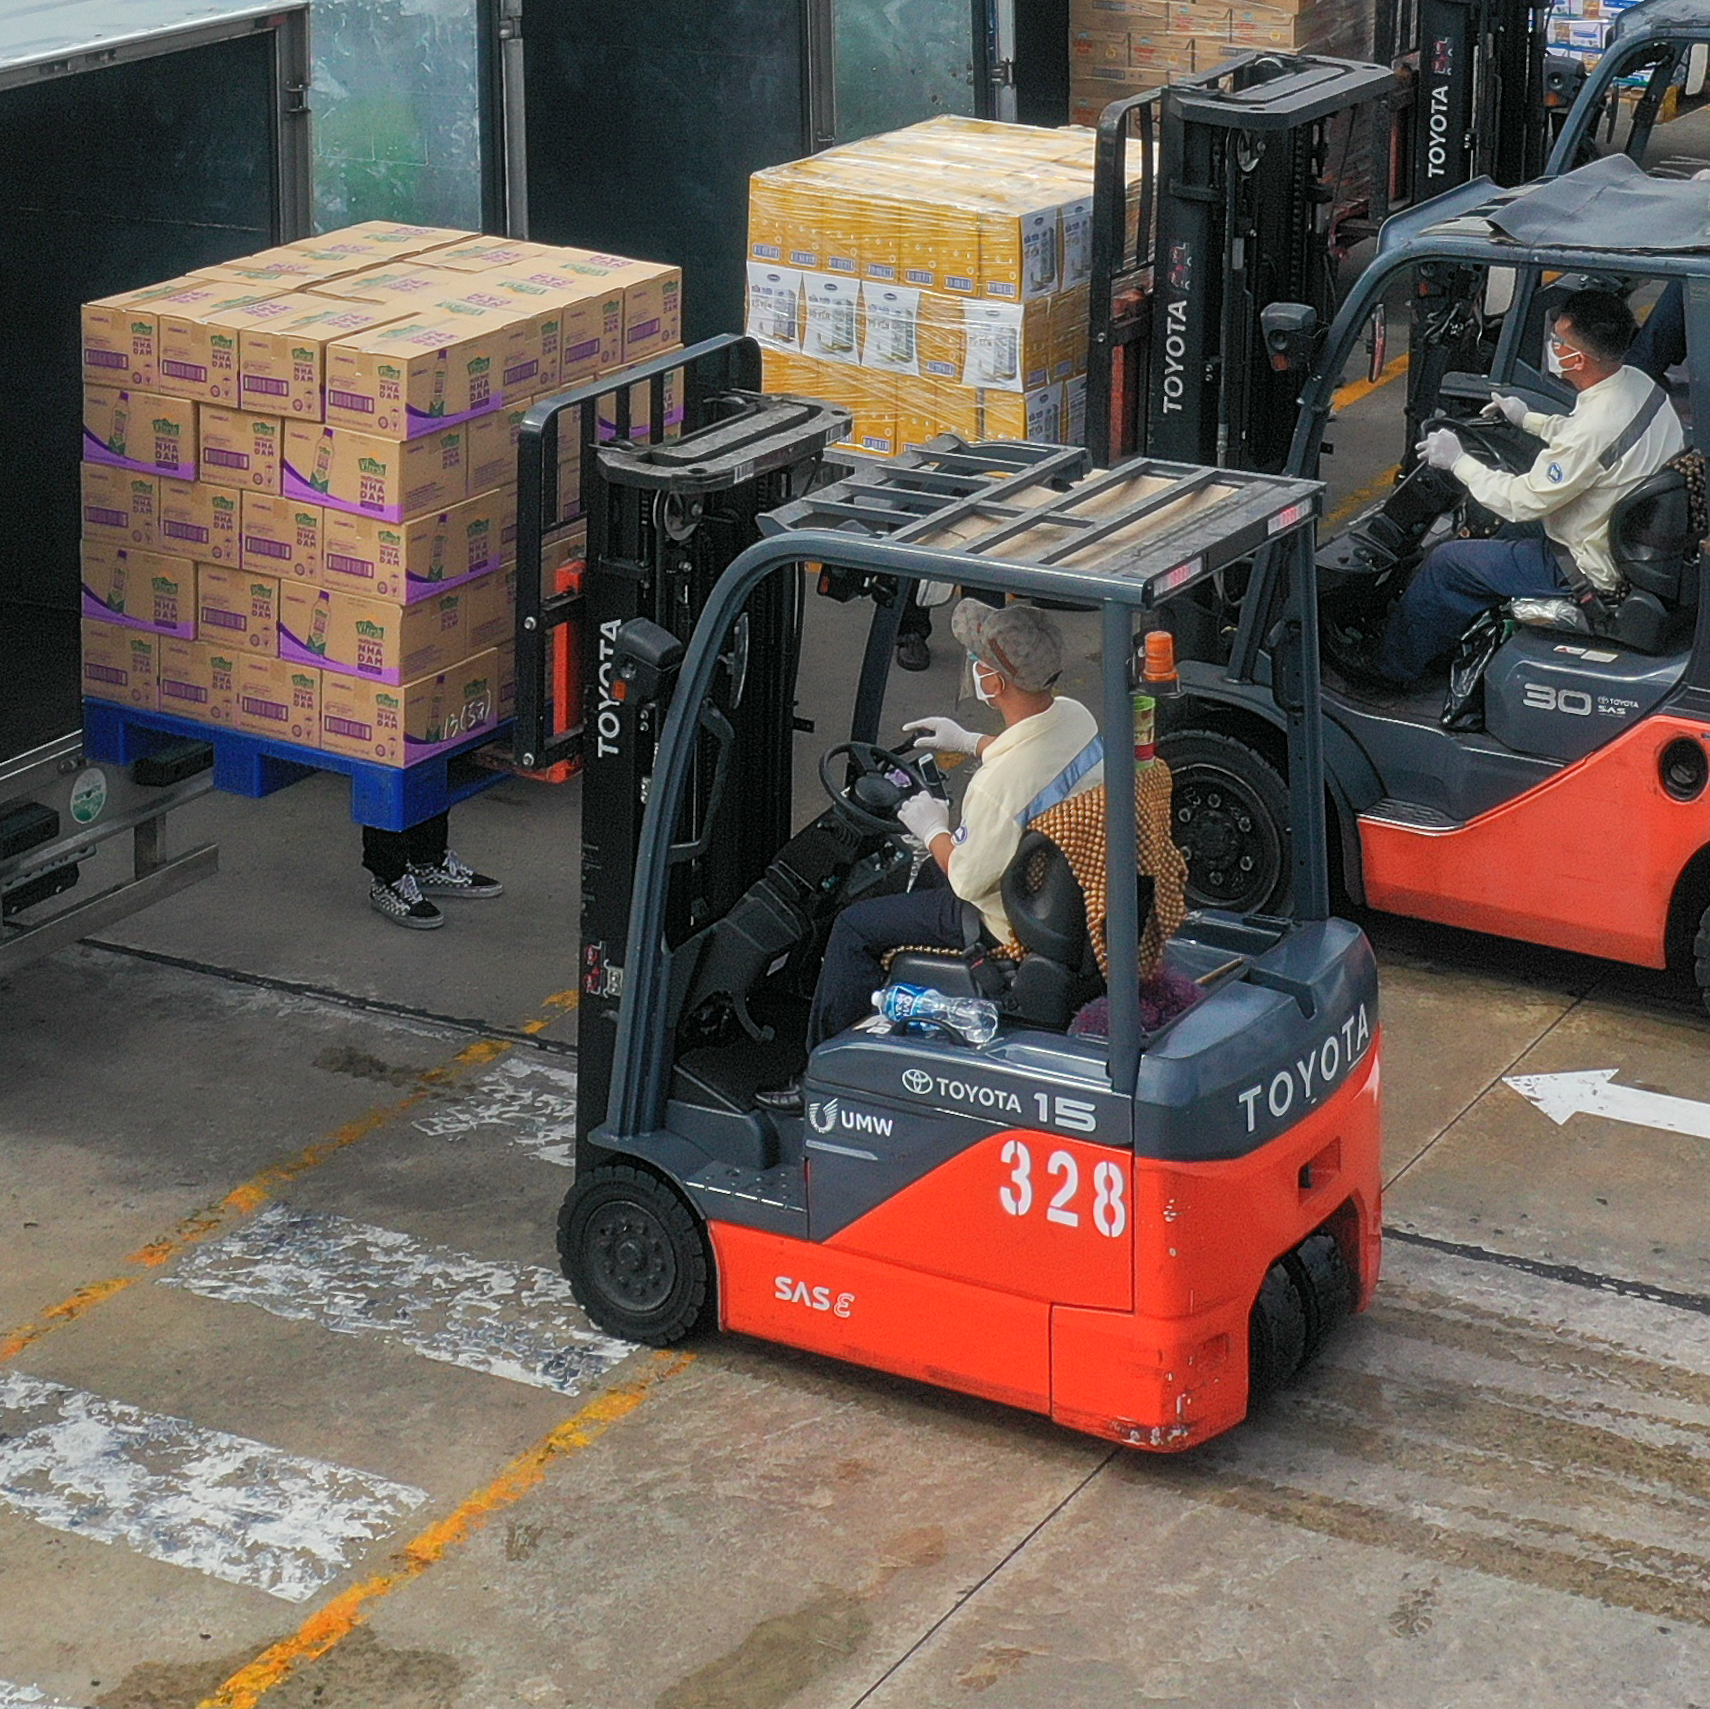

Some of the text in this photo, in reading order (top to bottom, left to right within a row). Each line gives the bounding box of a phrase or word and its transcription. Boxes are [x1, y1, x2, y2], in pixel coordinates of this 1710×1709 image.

[1428, 85, 1449, 178] TOYOTA
[1163, 300, 1187, 414] TOYOTA
[597, 618, 622, 758] TOYOTA
[1522, 682, 1592, 716] 30
[1597, 705, 1627, 716] SAS
[1609, 698, 1639, 709] TOYOTA
[936, 1076, 1097, 1132] TOYOTA 15
[1238, 1002, 1369, 1133] TOYOTA
[840, 1109, 893, 1137] UMW
[999, 1139, 1126, 1239] 328
